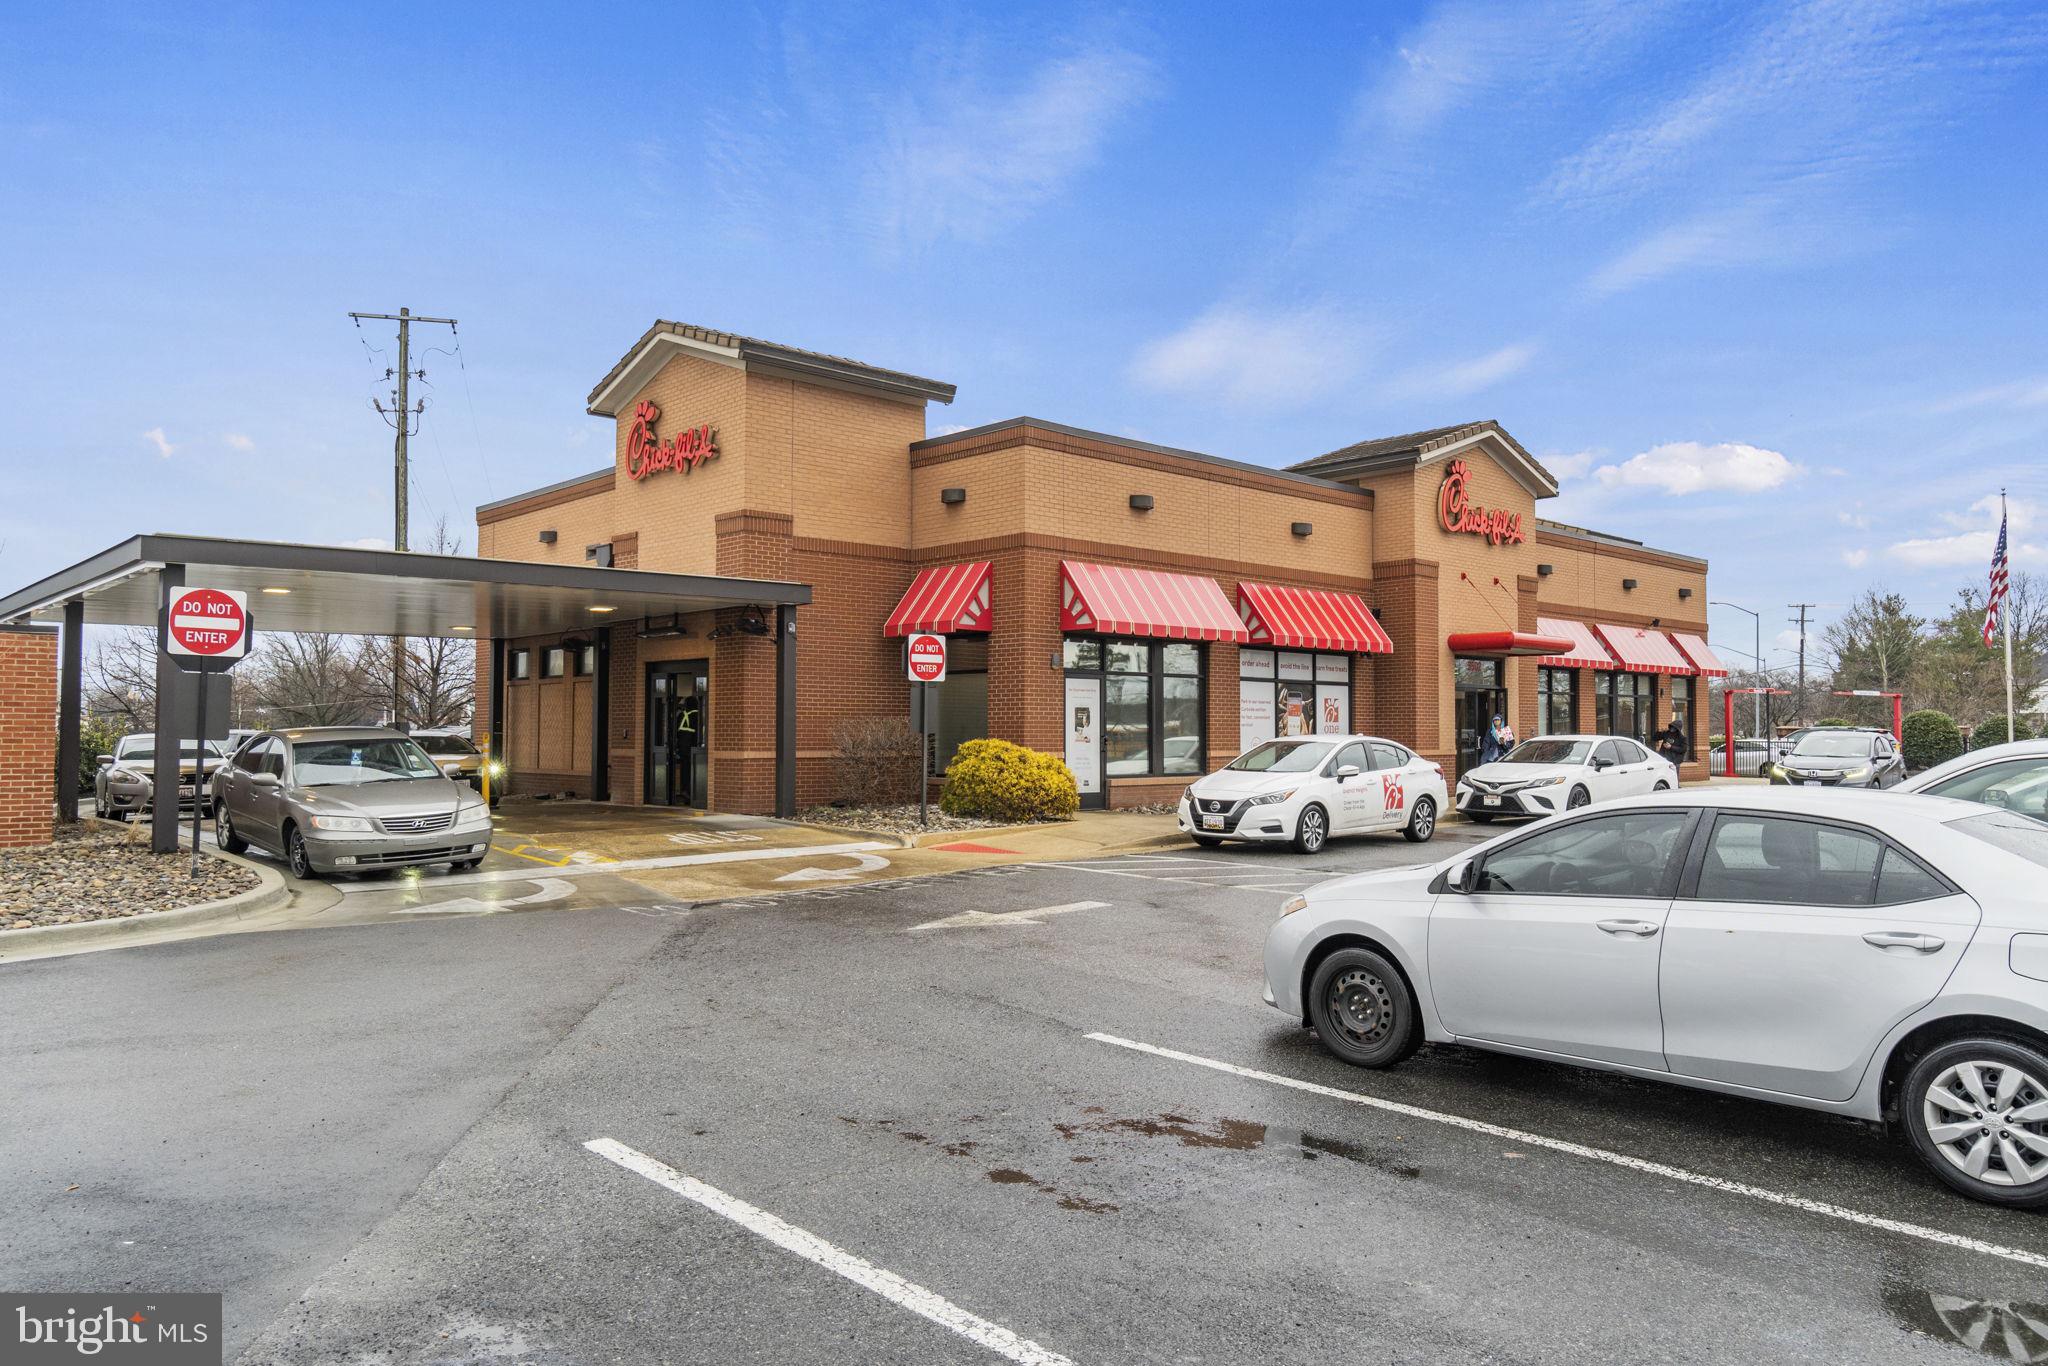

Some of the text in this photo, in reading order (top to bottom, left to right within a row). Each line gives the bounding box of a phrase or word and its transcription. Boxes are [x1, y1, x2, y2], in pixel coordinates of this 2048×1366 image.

[626, 400, 713, 480] Chick-fil-A
[1442, 459, 1526, 545] Chick-fil-A
[183, 601, 233, 615] DO NOT
[185, 631, 228, 644] ENTER
[915, 644, 940, 653] DO NOT
[916, 664, 937, 672] ENTER
[1324, 725, 1339, 734] one
[1383, 811, 1403, 819] Delivery
